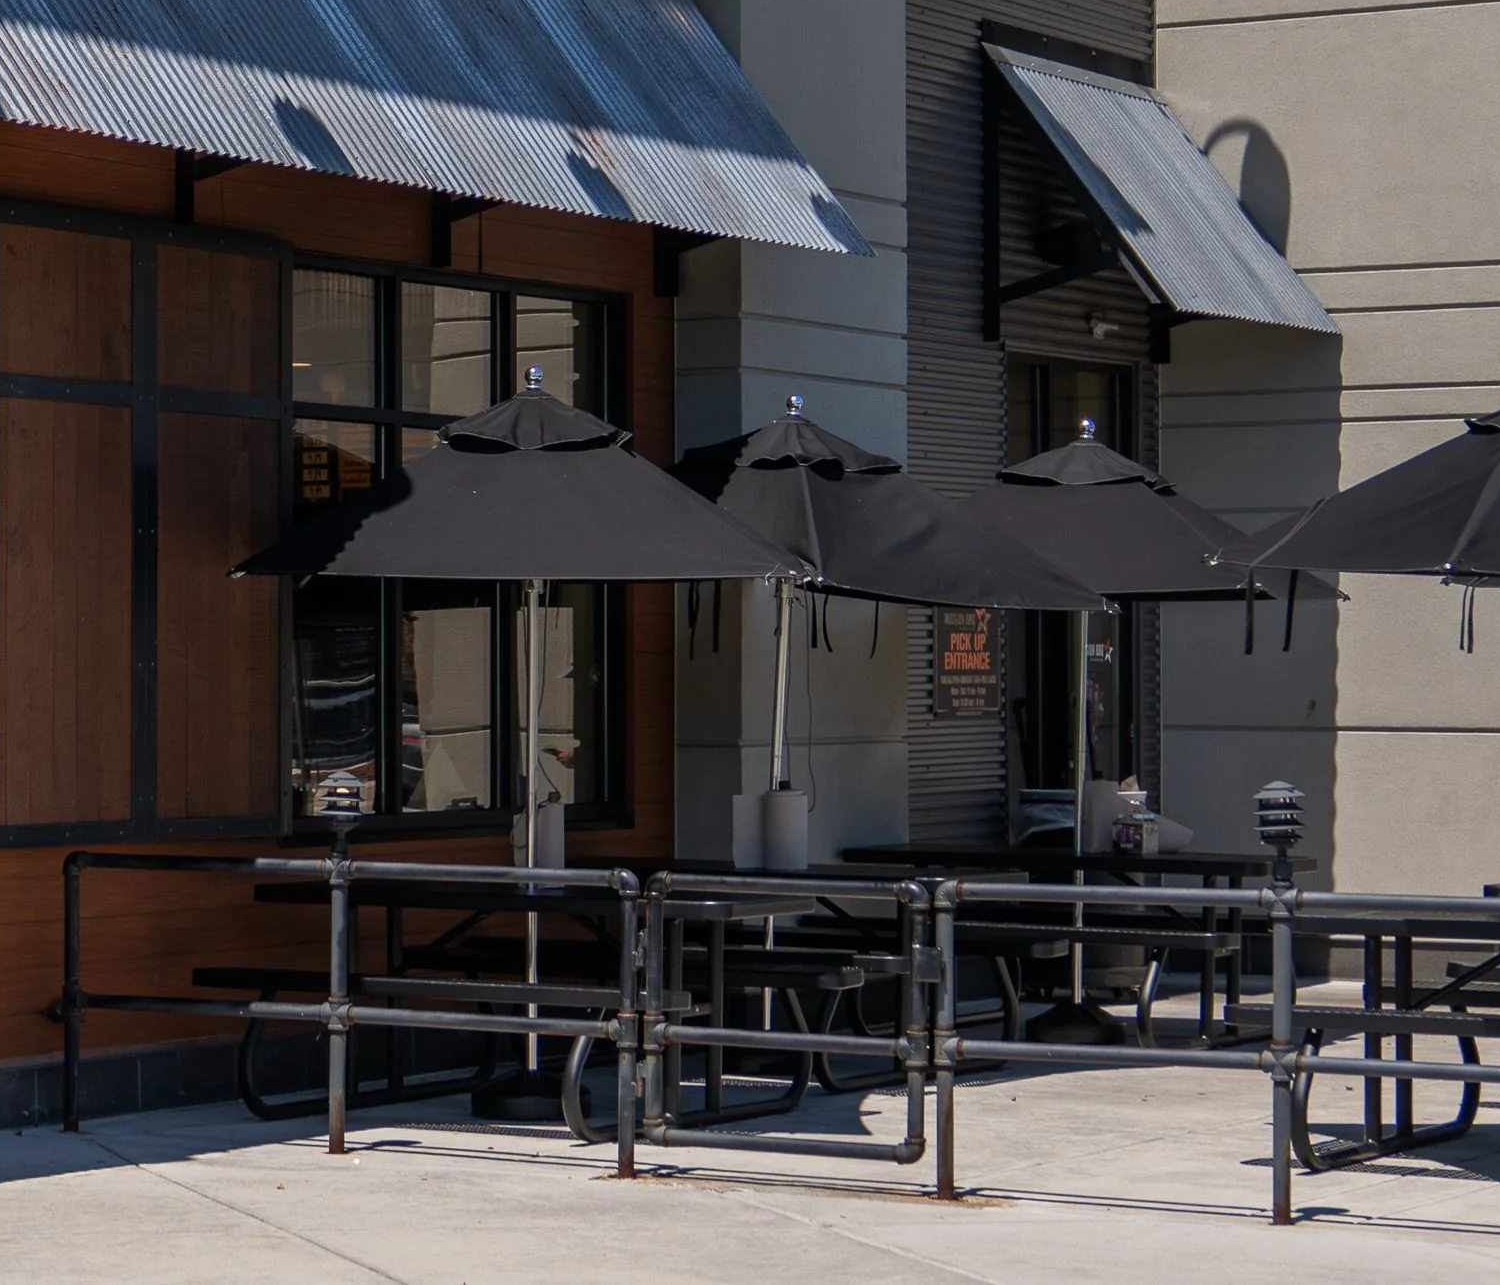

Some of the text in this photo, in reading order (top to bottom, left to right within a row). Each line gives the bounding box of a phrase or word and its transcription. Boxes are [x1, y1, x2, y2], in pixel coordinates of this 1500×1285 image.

[950, 633, 986, 651] PICK UP
[944, 652, 991, 670] ENTRANCE
